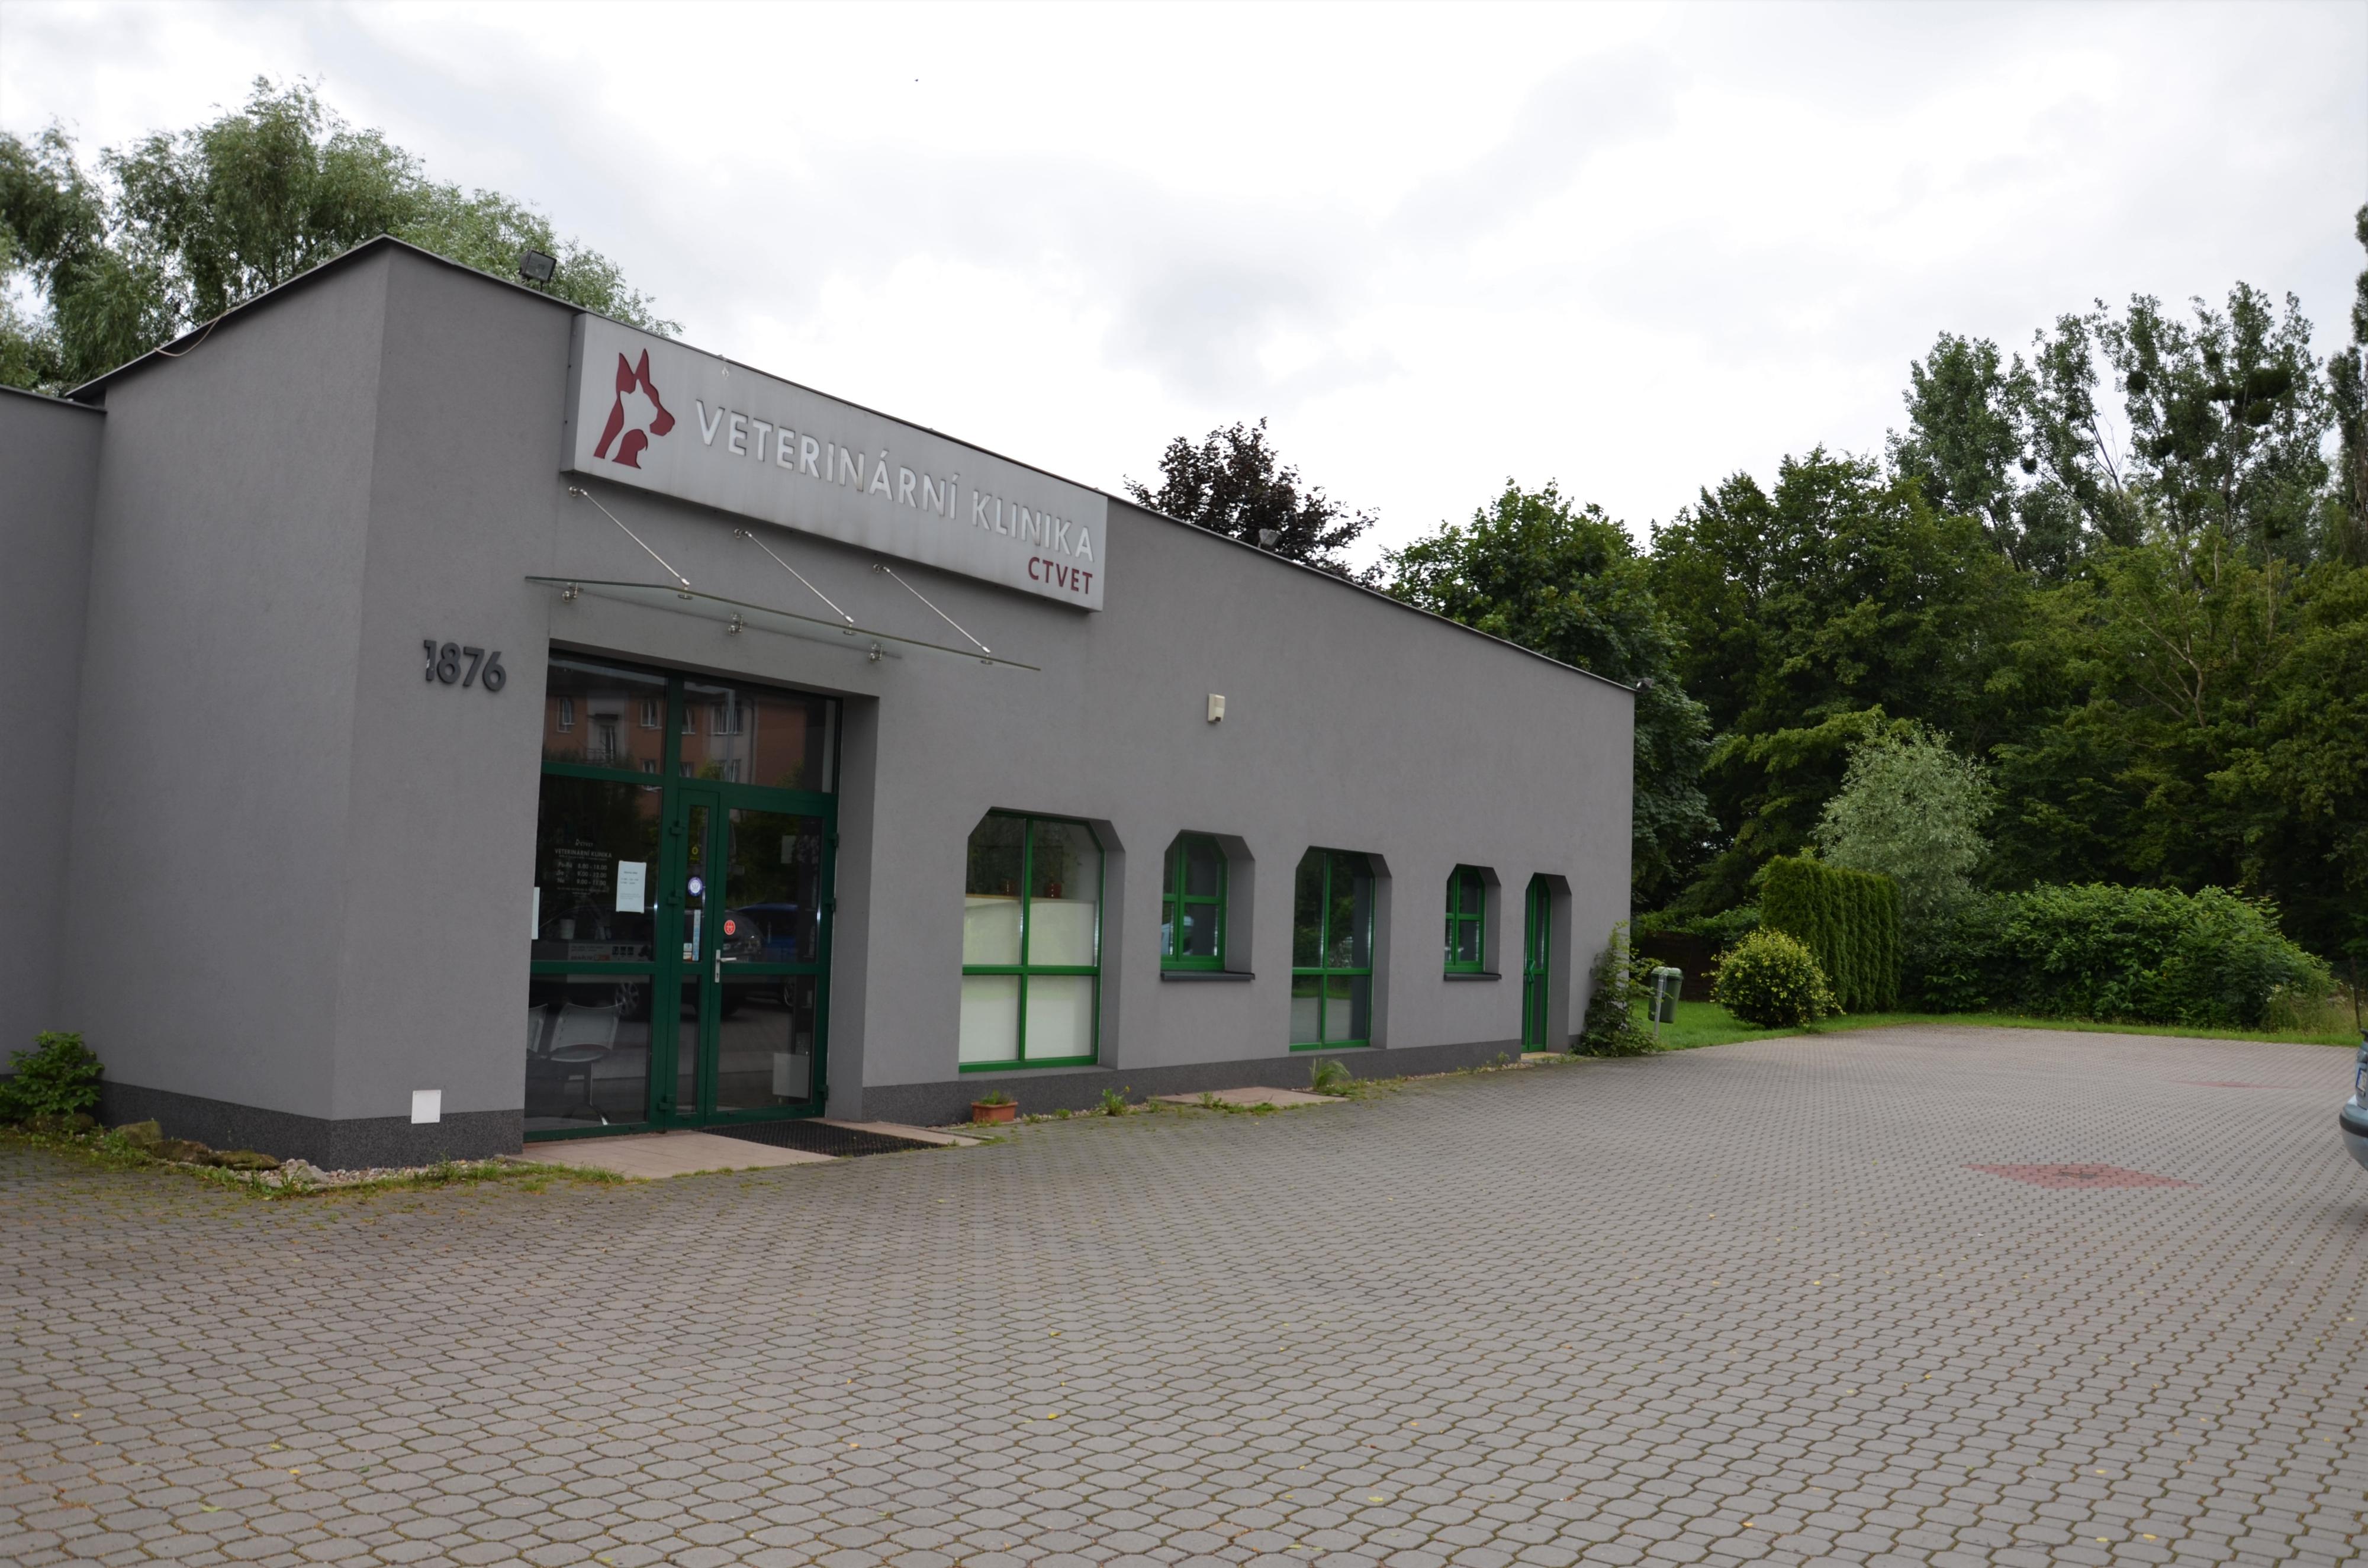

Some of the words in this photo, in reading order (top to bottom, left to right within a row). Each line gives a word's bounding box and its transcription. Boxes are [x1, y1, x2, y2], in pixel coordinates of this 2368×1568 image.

[696, 399, 960, 520] VETERINÁRNÍ
[972, 490, 1094, 562] KLINIKA
[1028, 556, 1093, 594] CTVET
[424, 639, 506, 692] 1876
